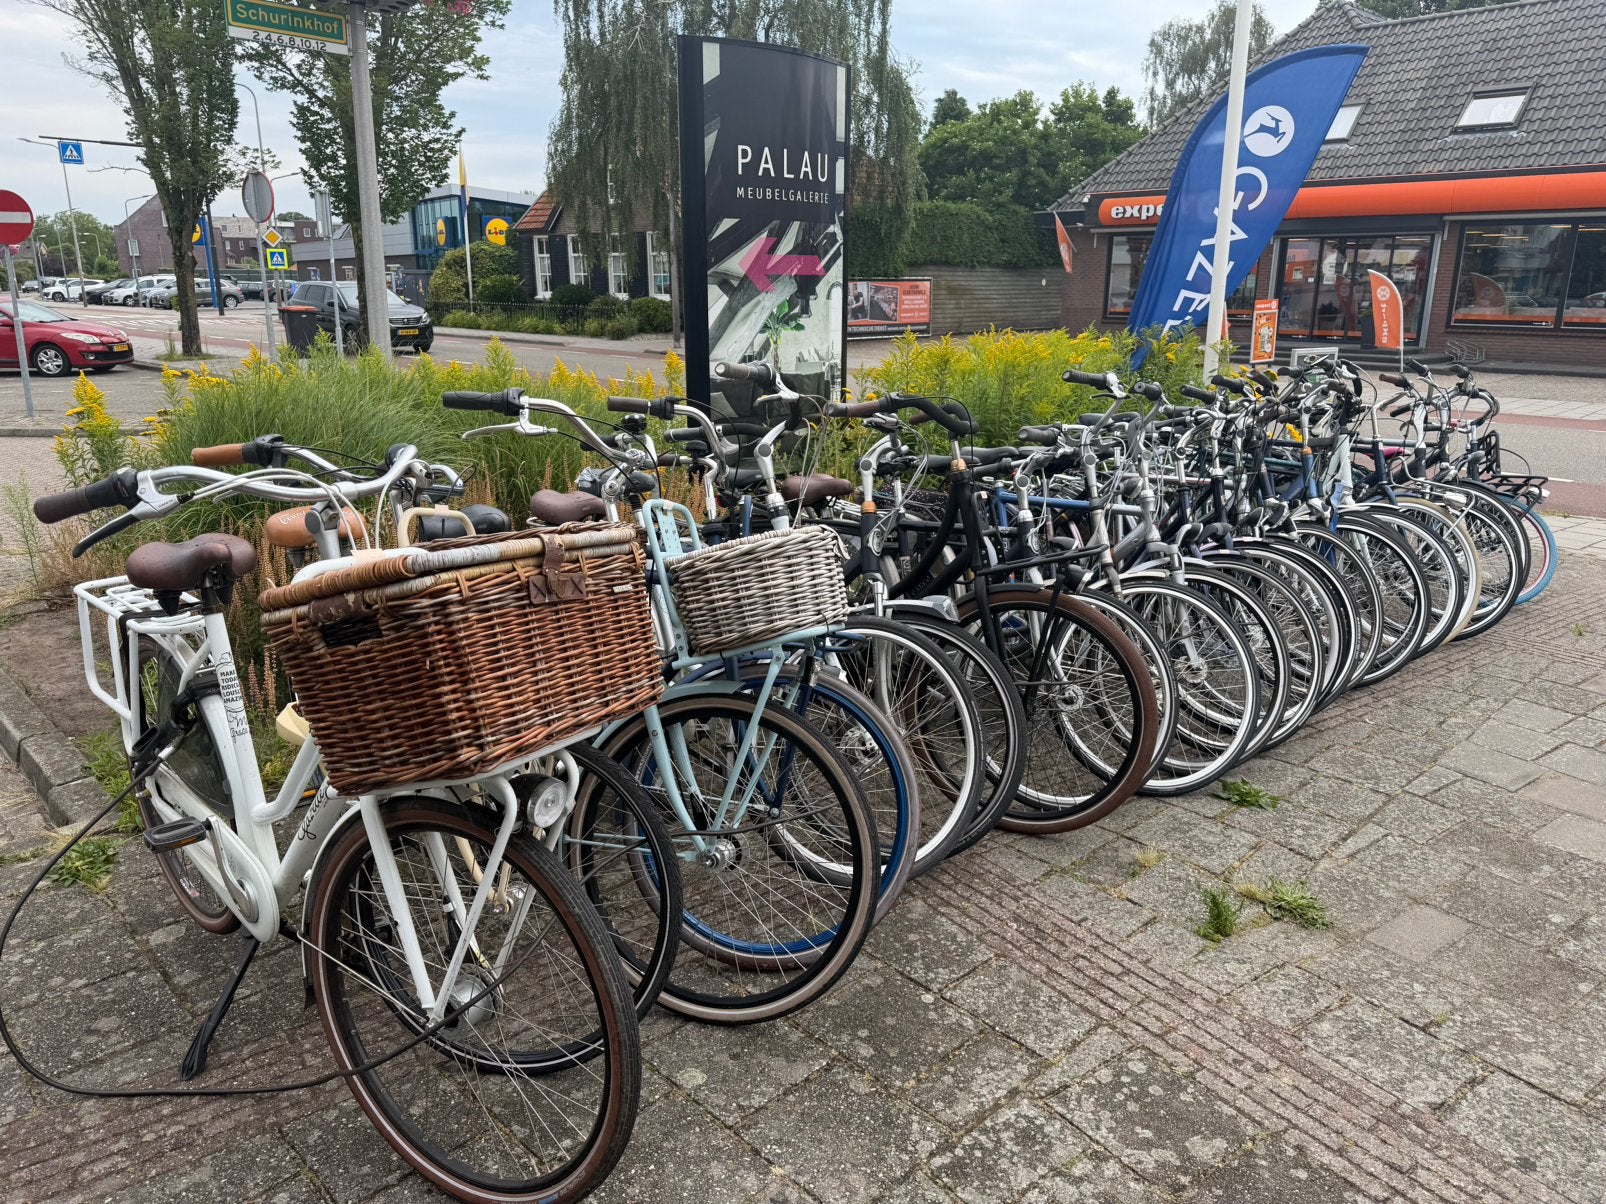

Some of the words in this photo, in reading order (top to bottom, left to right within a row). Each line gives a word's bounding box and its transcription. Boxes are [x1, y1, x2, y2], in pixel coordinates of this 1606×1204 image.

[236, 4, 340, 35] Schurinkhof
[737, 144, 828, 182] PALAU
[736, 186, 829, 204] MEUBELGALERIE
